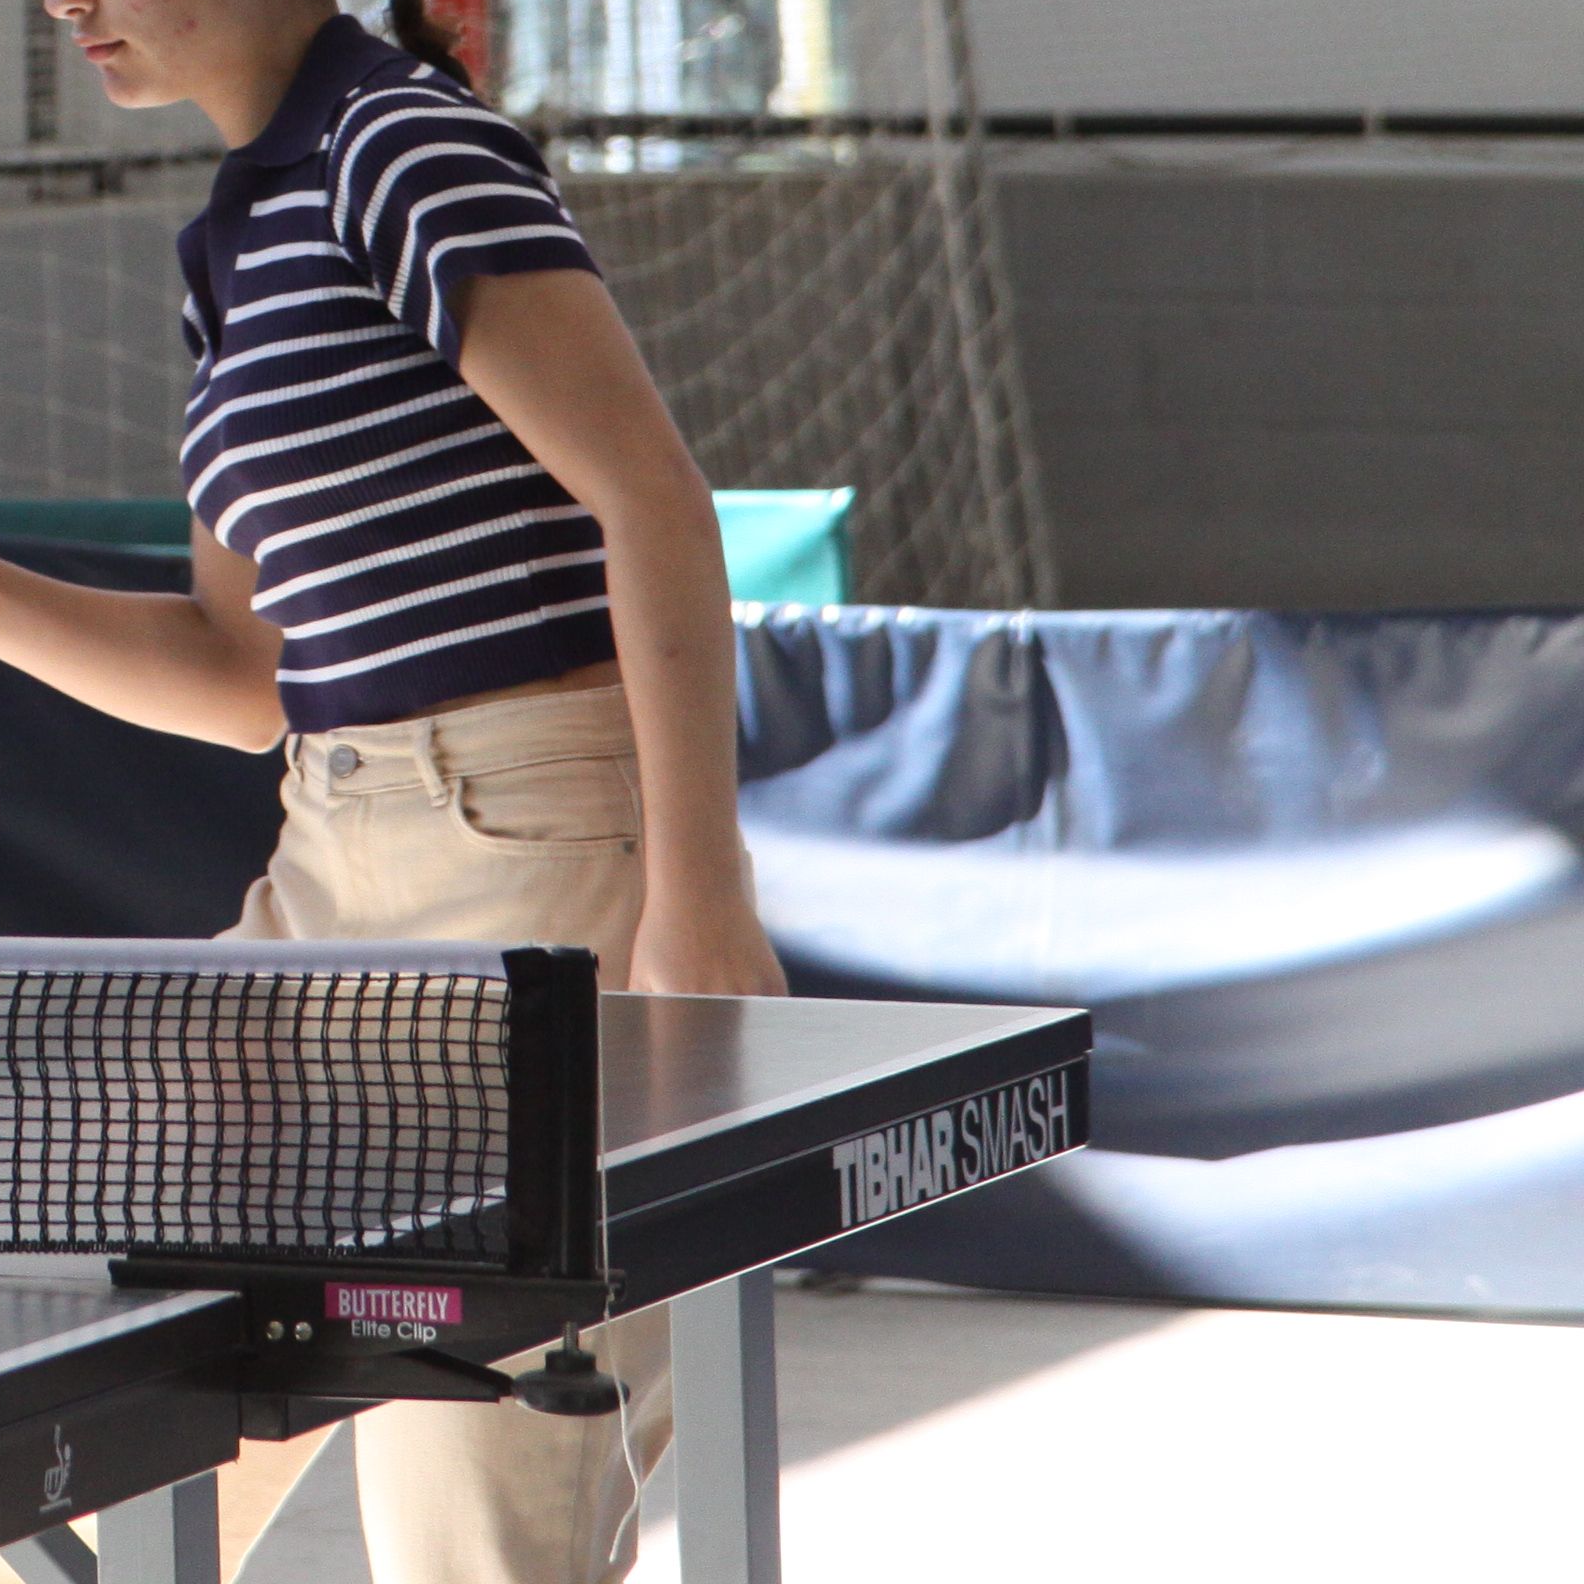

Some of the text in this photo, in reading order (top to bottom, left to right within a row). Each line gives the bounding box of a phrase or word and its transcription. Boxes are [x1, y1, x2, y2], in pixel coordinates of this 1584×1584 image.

[832, 1070, 1068, 1229] TIBHAR SMASH
[338, 1288, 449, 1321] BUTTERFLY
[351, 1319, 437, 1343] Elite Clip
